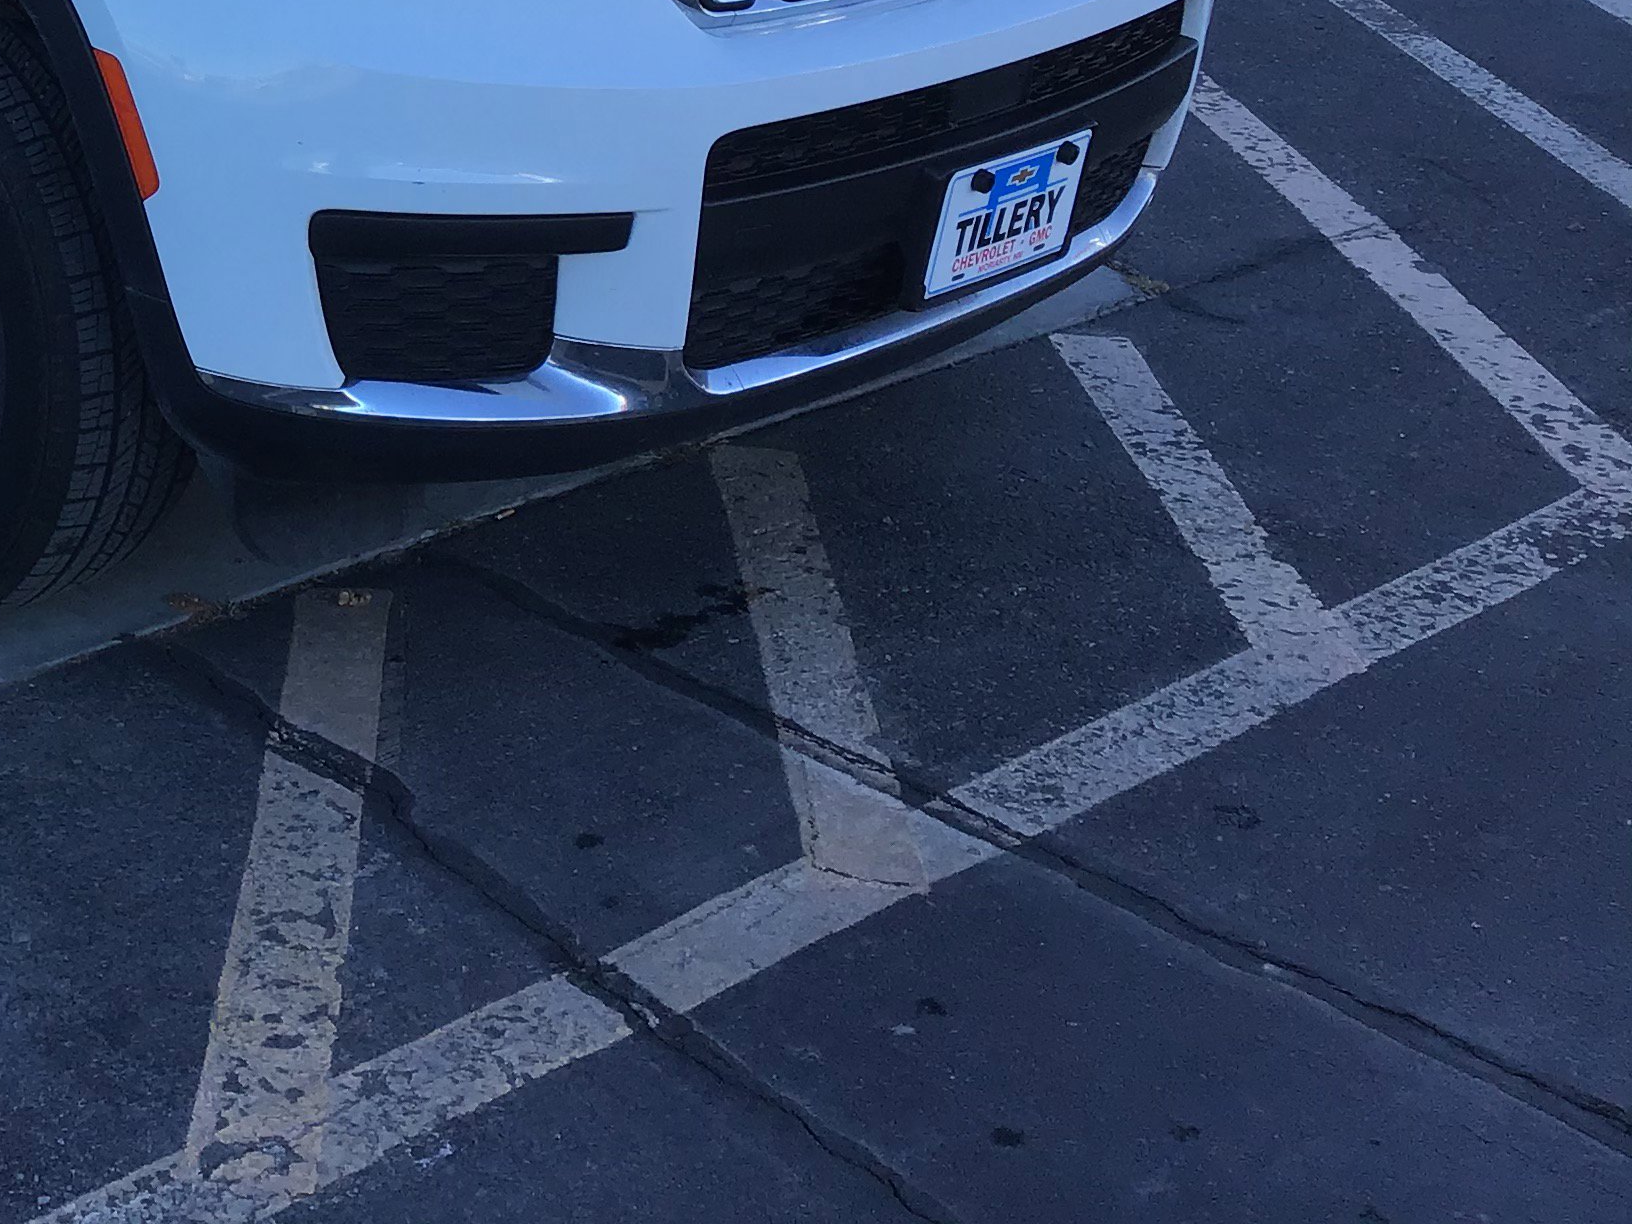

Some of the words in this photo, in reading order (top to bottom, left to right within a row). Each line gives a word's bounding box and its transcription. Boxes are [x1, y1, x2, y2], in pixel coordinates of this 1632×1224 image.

[952, 239, 1016, 273] CHEVROLET
[1028, 224, 1053, 247] GMC
[955, 185, 1066, 256] TILLERY
